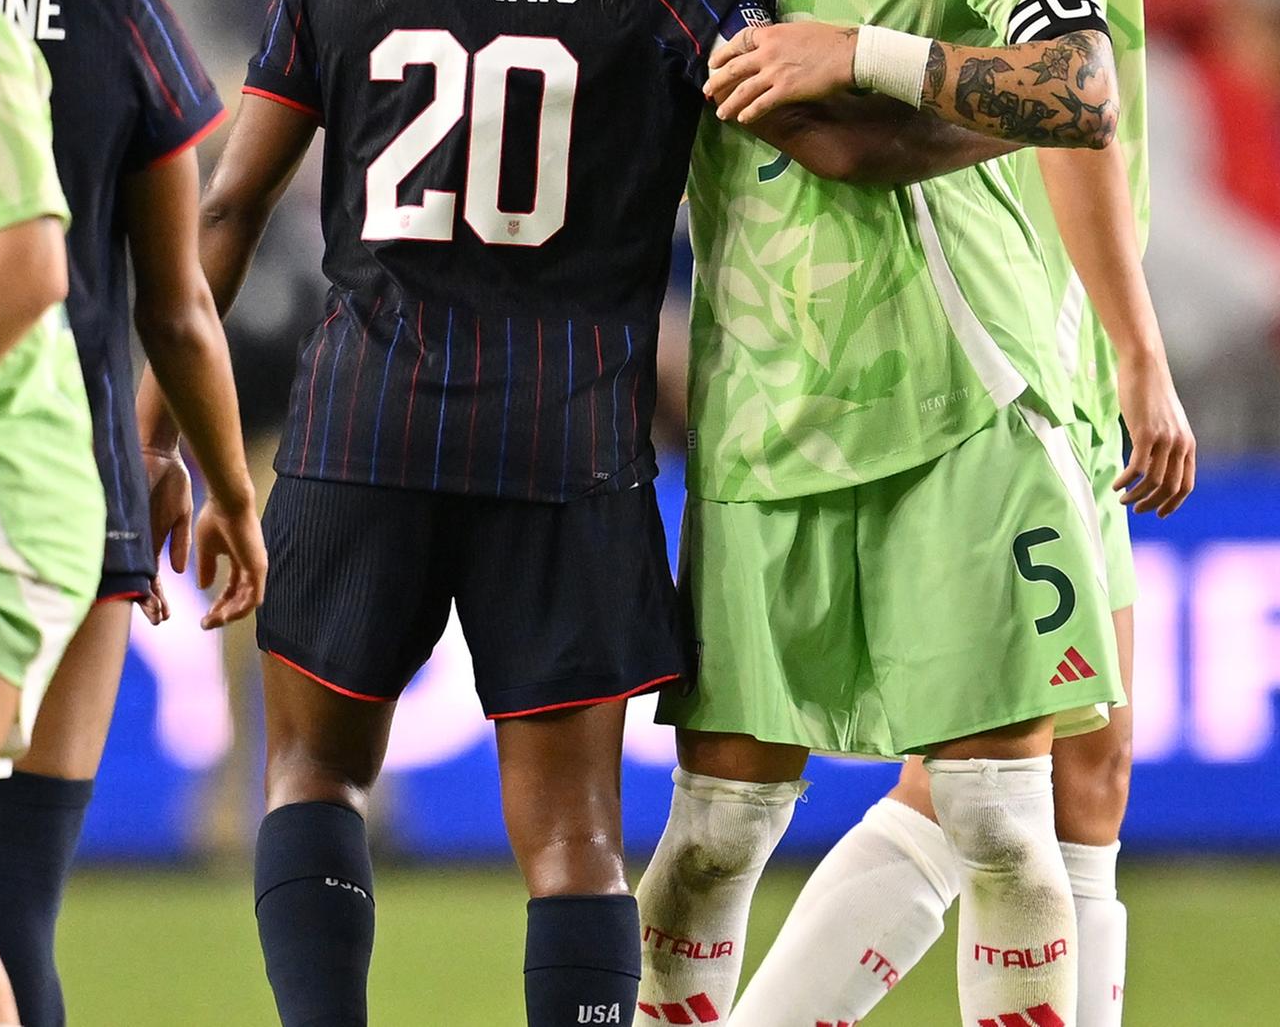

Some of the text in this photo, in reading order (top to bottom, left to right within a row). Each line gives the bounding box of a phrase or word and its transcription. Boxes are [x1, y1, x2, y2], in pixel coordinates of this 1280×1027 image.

[361, 28, 580, 248] 20
[1011, 525, 1078, 636] 5
[643, 925, 734, 960] ITALIA
[974, 938, 1067, 969] ITALIA
[577, 1002, 620, 1024] USA
